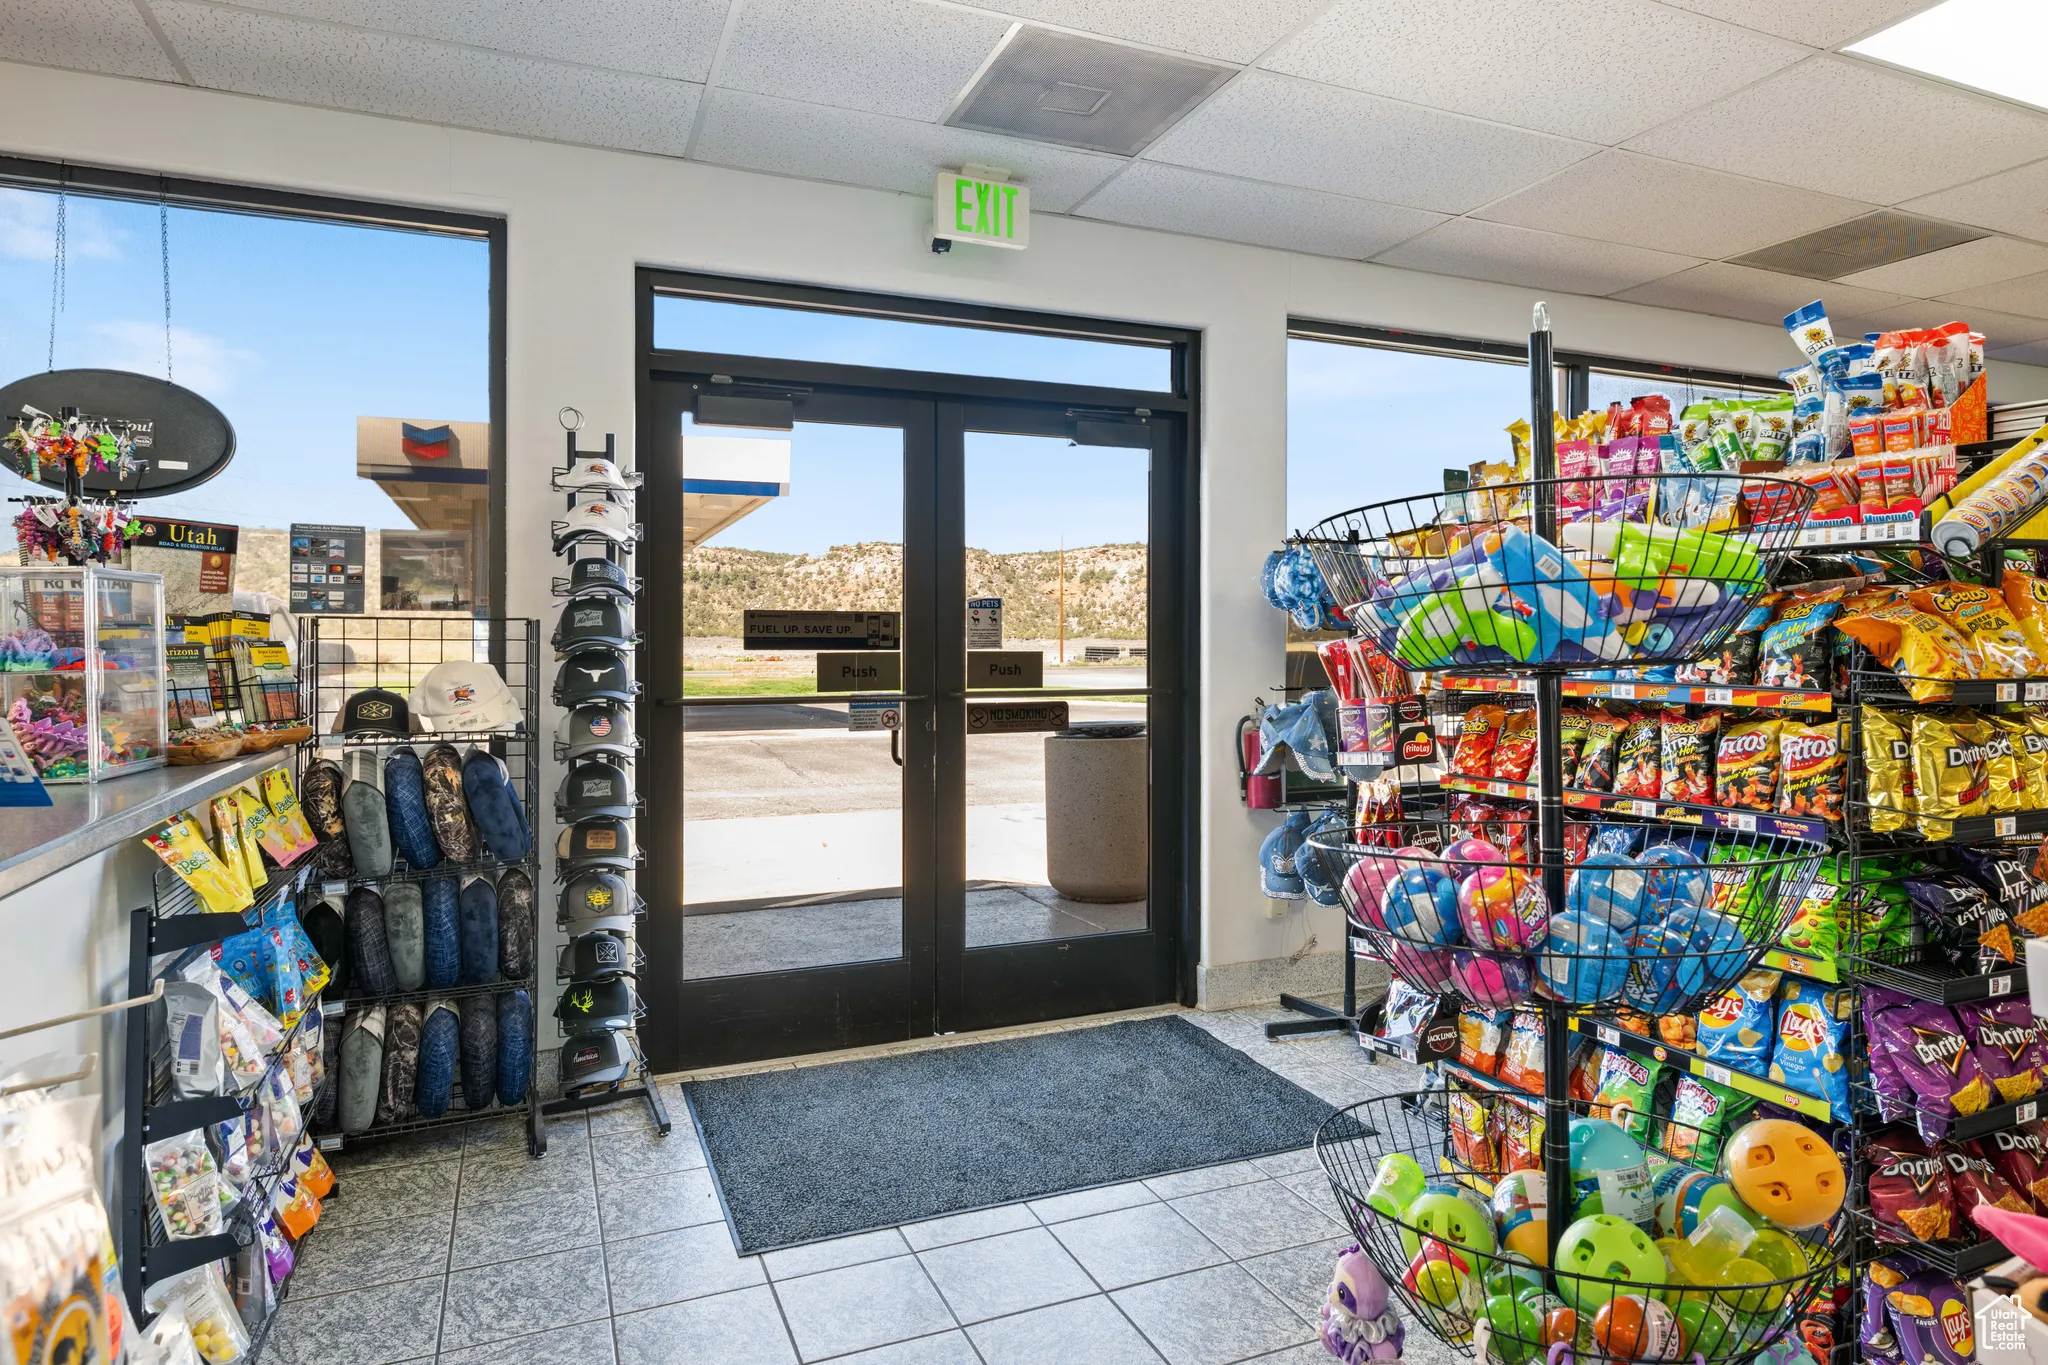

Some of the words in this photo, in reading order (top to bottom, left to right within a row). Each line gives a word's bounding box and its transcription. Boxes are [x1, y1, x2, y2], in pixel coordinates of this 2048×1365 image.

[955, 178, 1018, 239] EXIT
[1806, 338, 1834, 355] SPIT
[1760, 429, 1788, 441] SPITZ
[1884, 466, 1910, 476] MUNCHIES
[1993, 494, 2013, 510] Fritos
[1963, 513, 1986, 527] Fritos
[169, 524, 217, 545] Utah
[1934, 589, 1989, 611] Cheetos
[1960, 605, 1984, 618] Puffs
[750, 625, 780, 634] FUEL
[783, 625, 800, 634] UP.
[804, 625, 833, 634] SAVE
[837, 626, 853, 634] UP.
[1786, 622, 1809, 635] Hot
[842, 666, 877, 678] Push
[990, 664, 1022, 676] Push
[1781, 694, 1804, 706] Cheetos
[990, 709, 1005, 721] NO
[1005, 707, 1048, 720] SMOKING
[1679, 745, 1697, 755] Hot
[1719, 733, 1769, 758] Fritos
[1781, 737, 1838, 762] Fritos
[1950, 746, 1987, 766] Dorito
[1809, 773, 1831, 786] Hot
[1774, 820, 1809, 832] TURBOS
[2000, 881, 2029, 903] LATE
[1957, 903, 1987, 926] LATE
[1427, 1035, 1441, 1043] JACK
[1441, 1031, 1458, 1040] LINK'S
[573, 1051, 599, 1065] America
[1782, 1052, 1797, 1063] Salt
[1780, 1058, 1807, 1072] Vinegar
[1785, 1096, 1800, 1105] Lay's
[1915, 1319, 1939, 1327] SAVORY
[1943, 1309, 1971, 1345] Lay's
